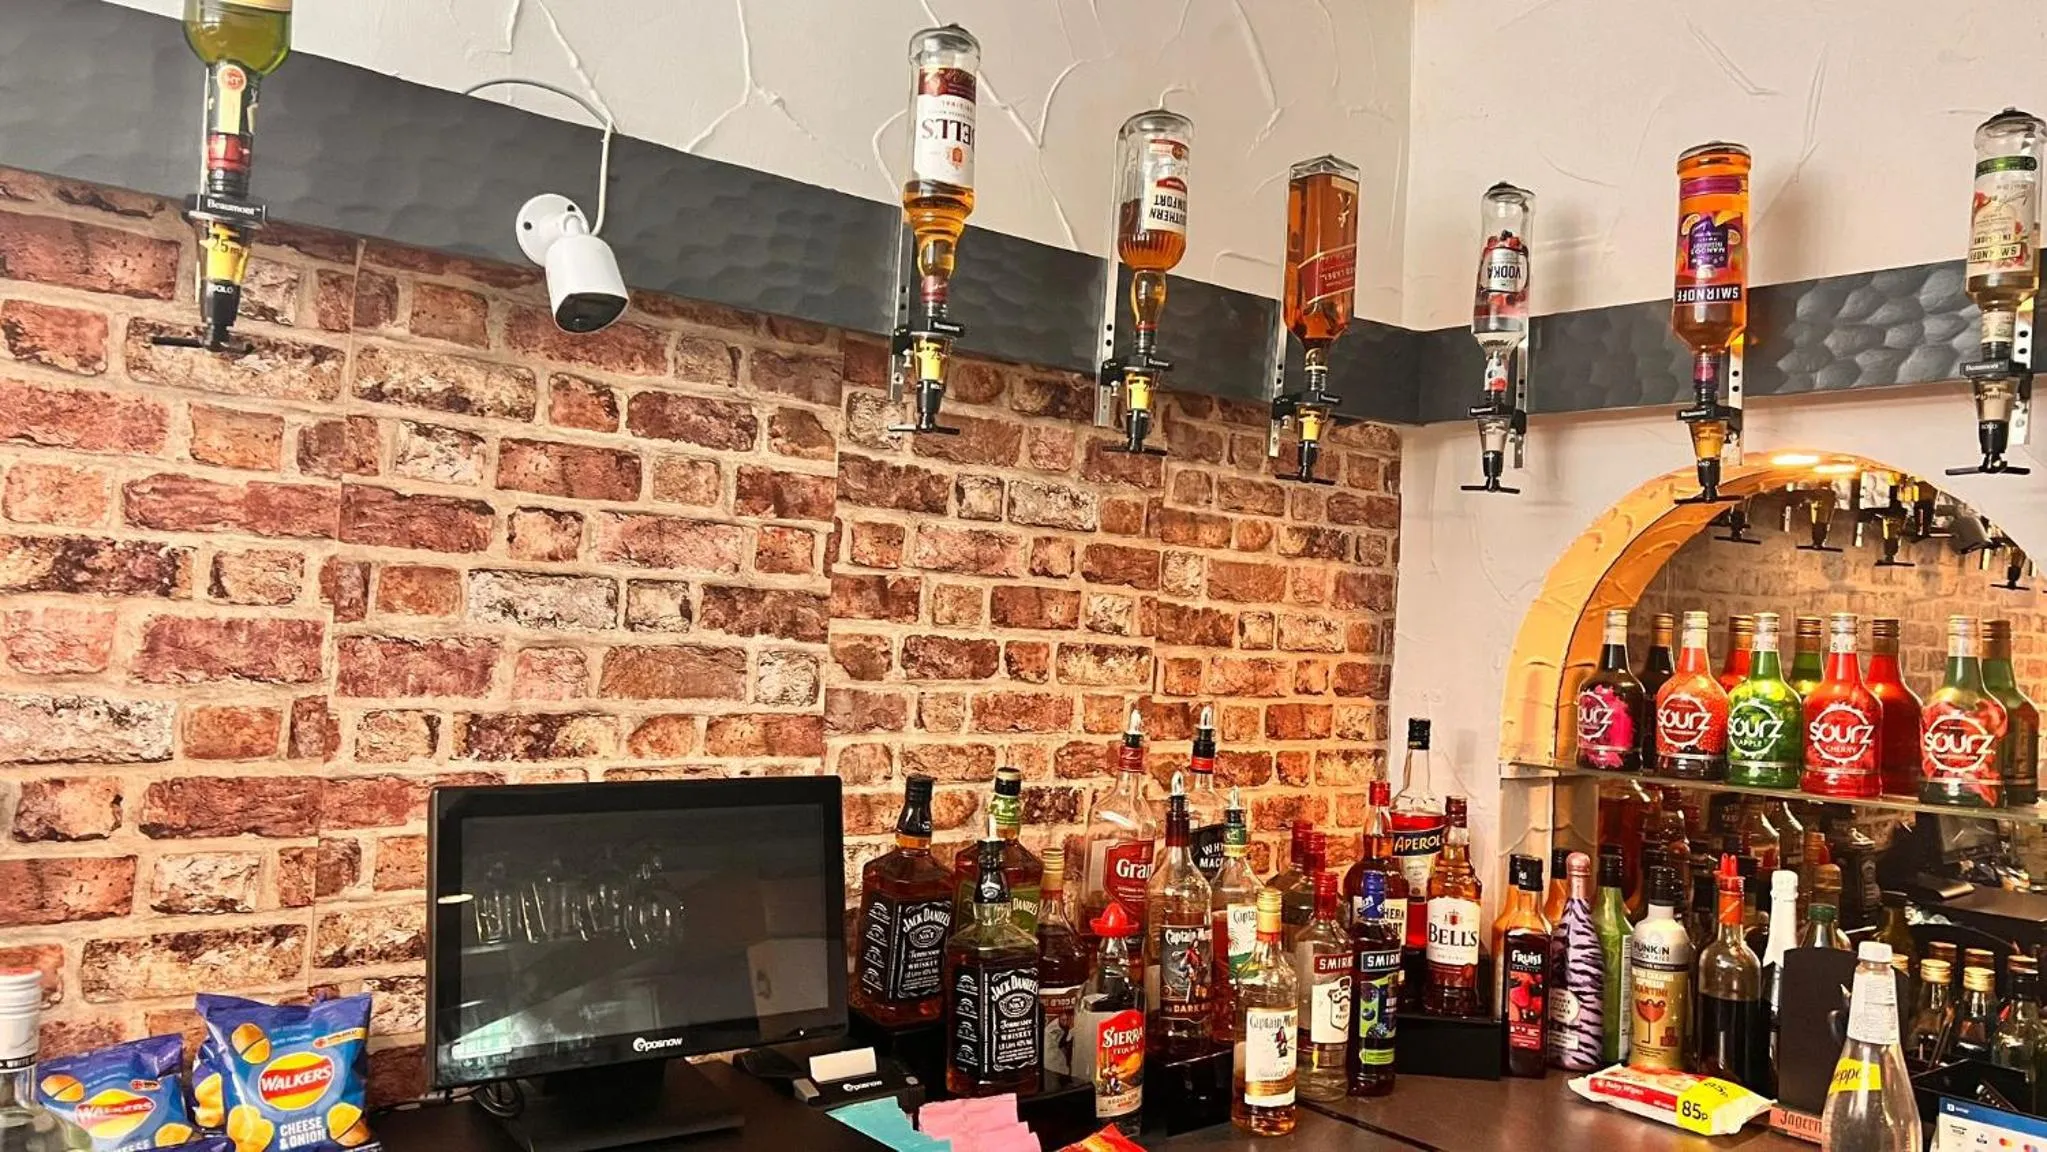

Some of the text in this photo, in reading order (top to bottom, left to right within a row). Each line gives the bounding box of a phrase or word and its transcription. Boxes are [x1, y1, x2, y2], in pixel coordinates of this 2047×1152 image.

[921, 118, 975, 152] ELL'S
[1970, 246, 2018, 262] SMNOFF
[1487, 265, 1521, 280] VODKA
[1676, 286, 1739, 302] SMIRNOFF
[1577, 706, 1614, 724] ourz
[1657, 708, 1713, 731] sourz
[1728, 717, 1784, 740] sourz
[1809, 720, 1875, 746] sourz
[1738, 739, 1763, 747] APPLE
[1825, 745, 1857, 753] CHERRY
[1924, 732, 1996, 755] sourz
[1394, 835, 1441, 853] APEROL
[903, 911, 923, 933] JACK
[1165, 929, 1197, 945] Captain
[1428, 921, 1478, 947] BELL'S
[991, 981, 1011, 1002] JACK
[1173, 1003, 1200, 1014] DARK
[1249, 1013, 1282, 1030] Captain
[1000, 1030, 1032, 1041] WHISKEY
[1103, 1025, 1143, 1048] SIERRA
[261, 1065, 332, 1092] WALKERS
[1681, 1100, 1708, 1121] 85p
[279, 1116, 323, 1137] CHEESE
